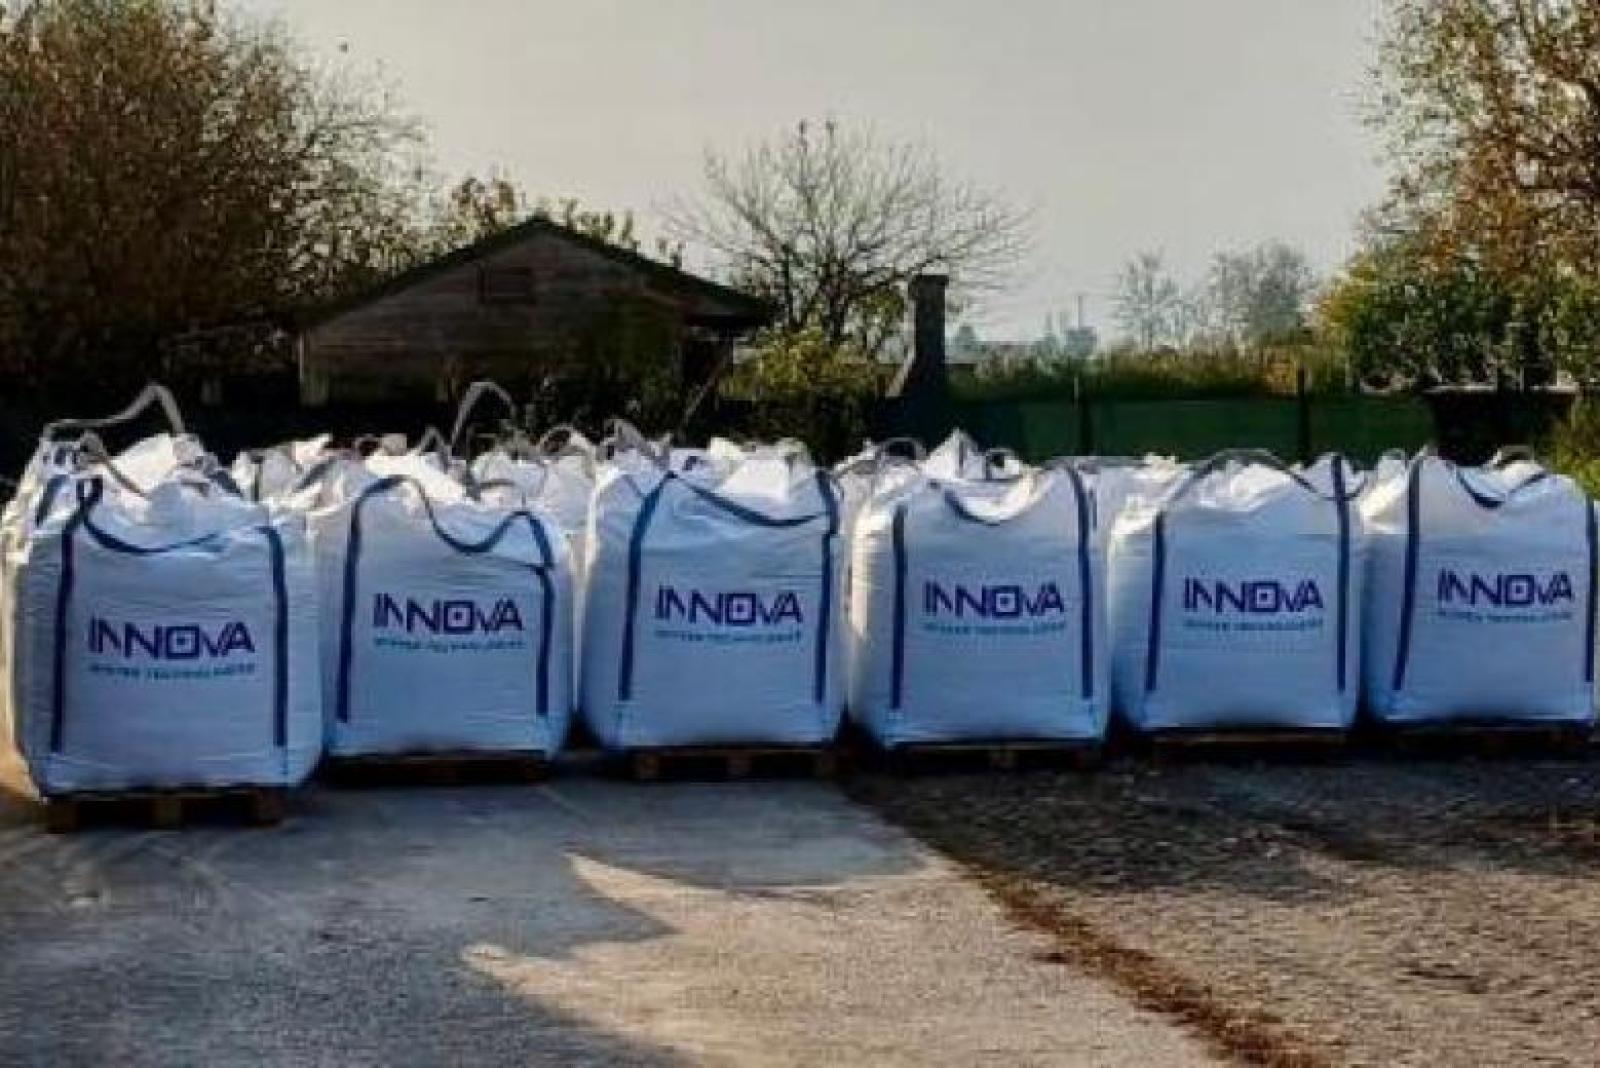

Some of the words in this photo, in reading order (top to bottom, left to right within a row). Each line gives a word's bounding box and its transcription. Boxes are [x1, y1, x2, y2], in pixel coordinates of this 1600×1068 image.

[656, 583, 804, 627] INNOVA
[924, 579, 1066, 619] INNOVA
[1183, 577, 1324, 613] INNOVA
[1437, 568, 1574, 605] INNOVA
[373, 593, 526, 635] INNOVA
[88, 616, 256, 660] INNOVA
